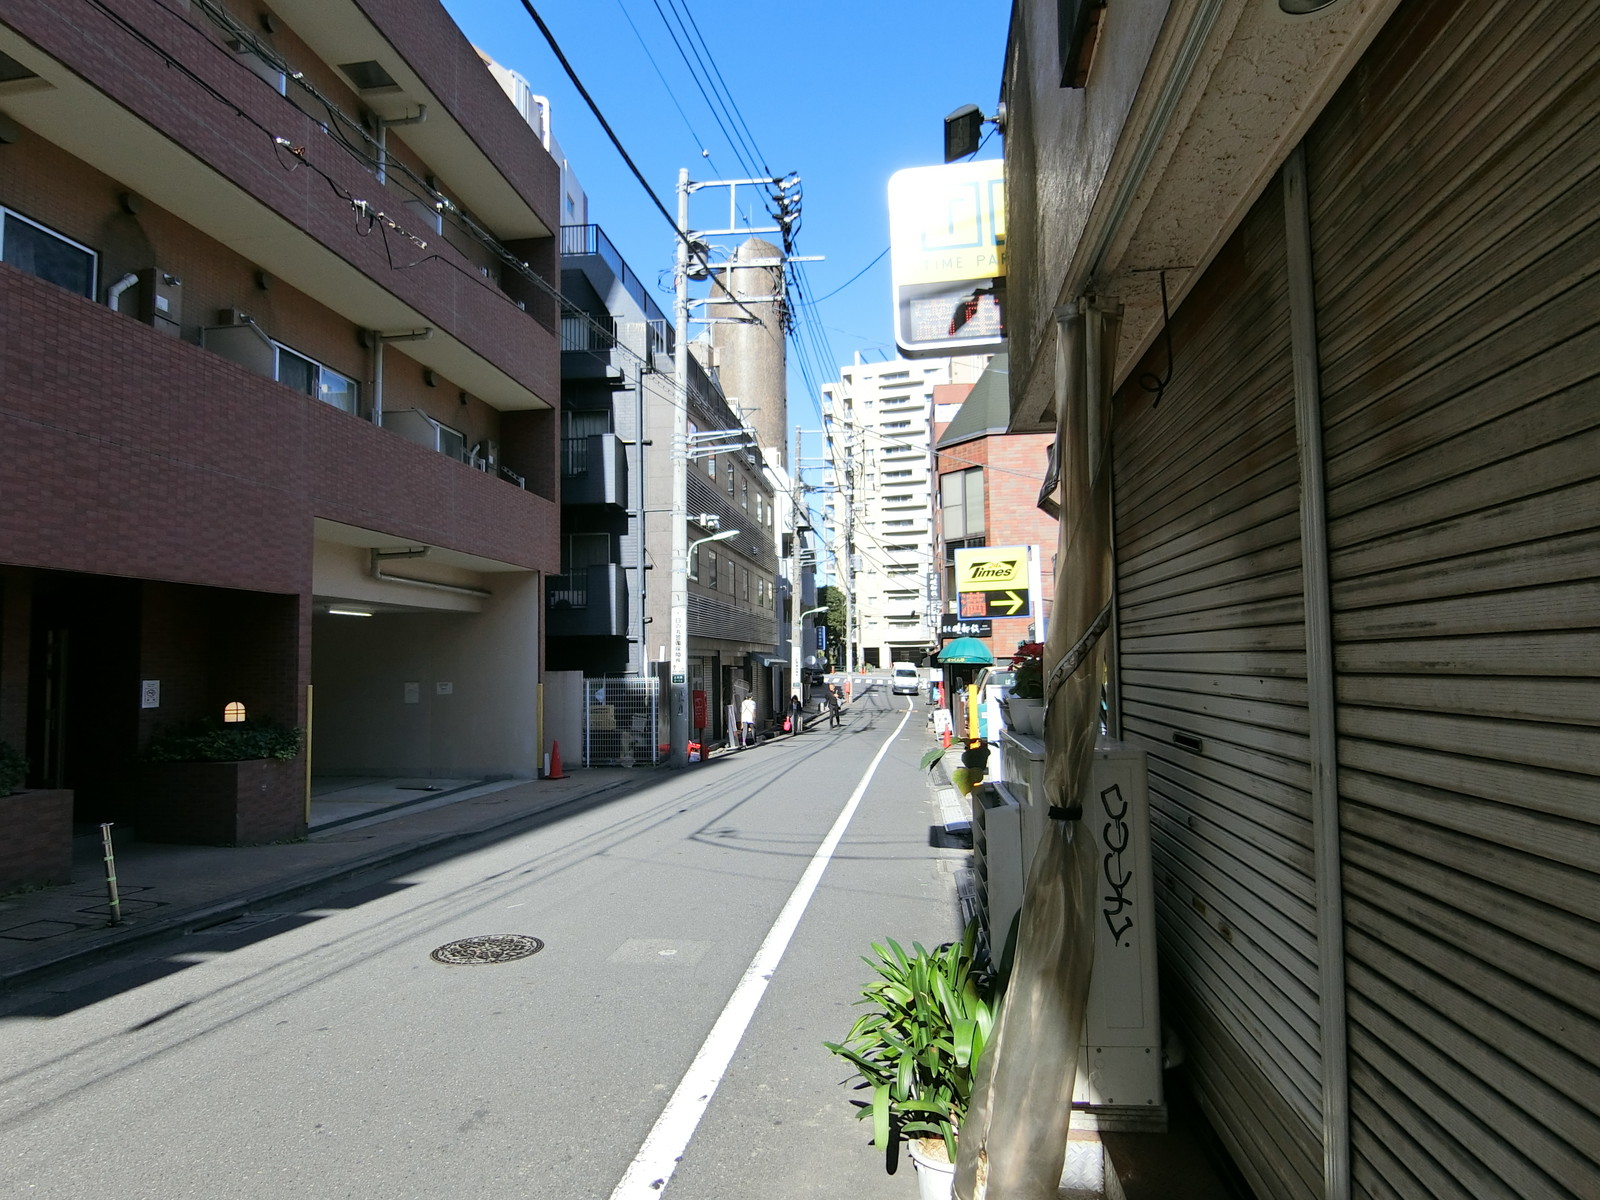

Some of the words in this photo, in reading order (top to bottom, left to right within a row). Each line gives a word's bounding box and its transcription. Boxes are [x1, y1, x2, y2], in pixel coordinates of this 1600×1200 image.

[923, 256, 964, 271] TIME
[969, 560, 1017, 579] Times
[960, 591, 987, 617] 満
